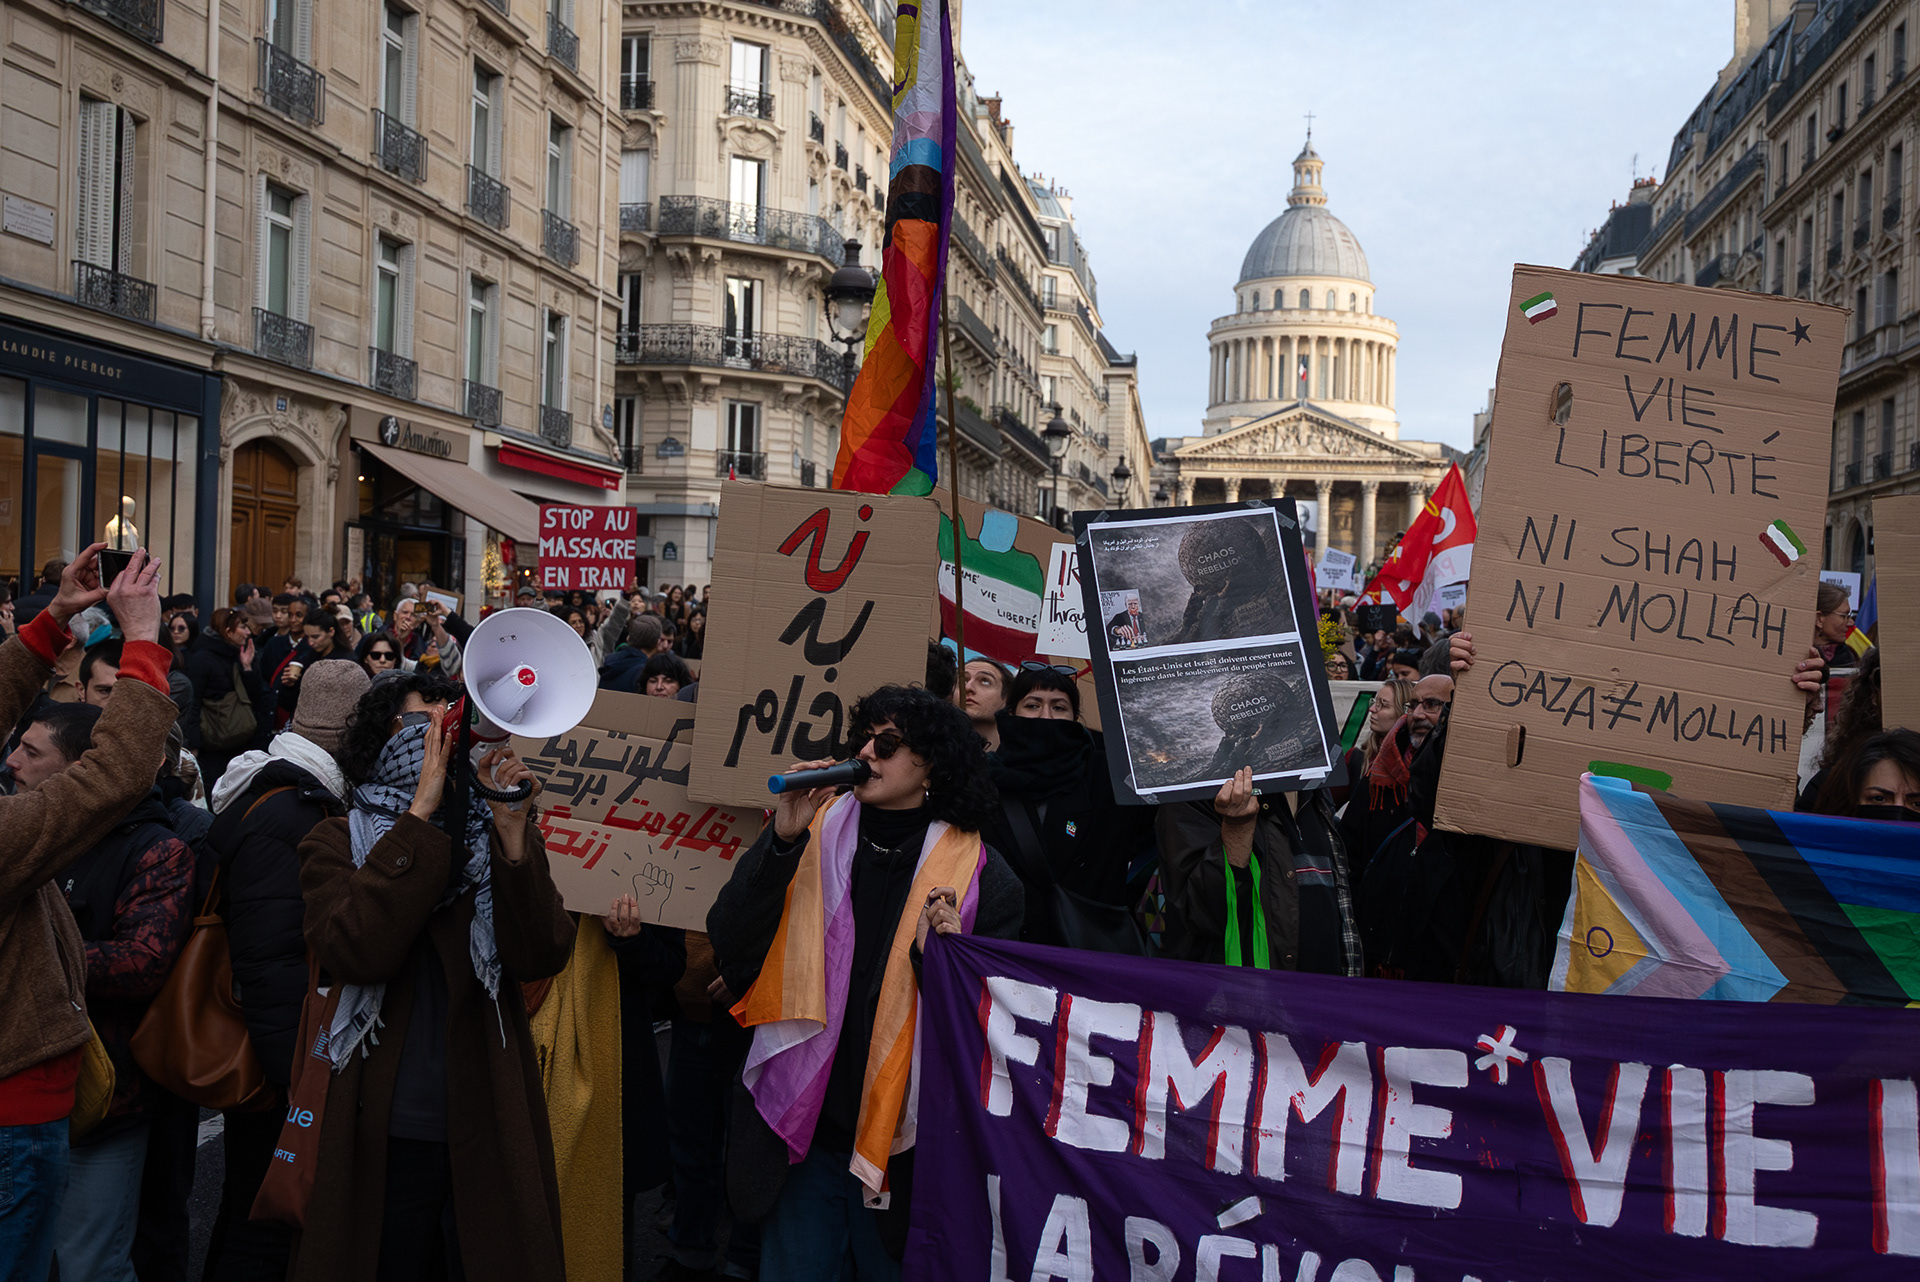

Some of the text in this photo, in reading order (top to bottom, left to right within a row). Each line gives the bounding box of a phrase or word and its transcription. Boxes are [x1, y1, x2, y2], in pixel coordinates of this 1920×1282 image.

[2, 340, 122, 379] LAUDIE PIERLOT
[1624, 374, 1724, 434] VIE
[1554, 426, 1781, 500] LIBERTÉ
[543, 507, 630, 531] STOP AU
[538, 535, 636, 560] MASSACRE
[1197, 546, 1236, 564] CHAOS
[1517, 514, 1576, 565] NI
[1600, 526, 1737, 582] SHAH
[544, 566, 625, 588] EN IRAN
[1058, 550, 1082, 588] IR
[980, 588, 998, 603] VIE
[997, 608, 1038, 629] LIBERTÉ
[1505, 579, 1564, 629] NI
[1596, 580, 1788, 656] MOLLAH
[1120, 675, 1156, 684] ingérence
[1156, 672, 1176, 680] dans
[1184, 666, 1229, 676] soulèvement
[1241, 661, 1266, 672] peuple
[1267, 658, 1296, 667] iranien.
[1137, 663, 1182, 674] États-Unis
[1193, 658, 1217, 668] Israël
[1218, 655, 1248, 664] doivent
[1248, 653, 1272, 661] cesser
[1229, 702, 1276, 722] REBELLION
[1230, 695, 1268, 711] CHAOS
[579, 718, 692, 807] کوت
[538, 804, 612, 870] زندگ
[601, 797, 743, 862] مقاومت
[286, 1104, 314, 1128] ue
[1532, 1057, 1820, 1249] VIE
